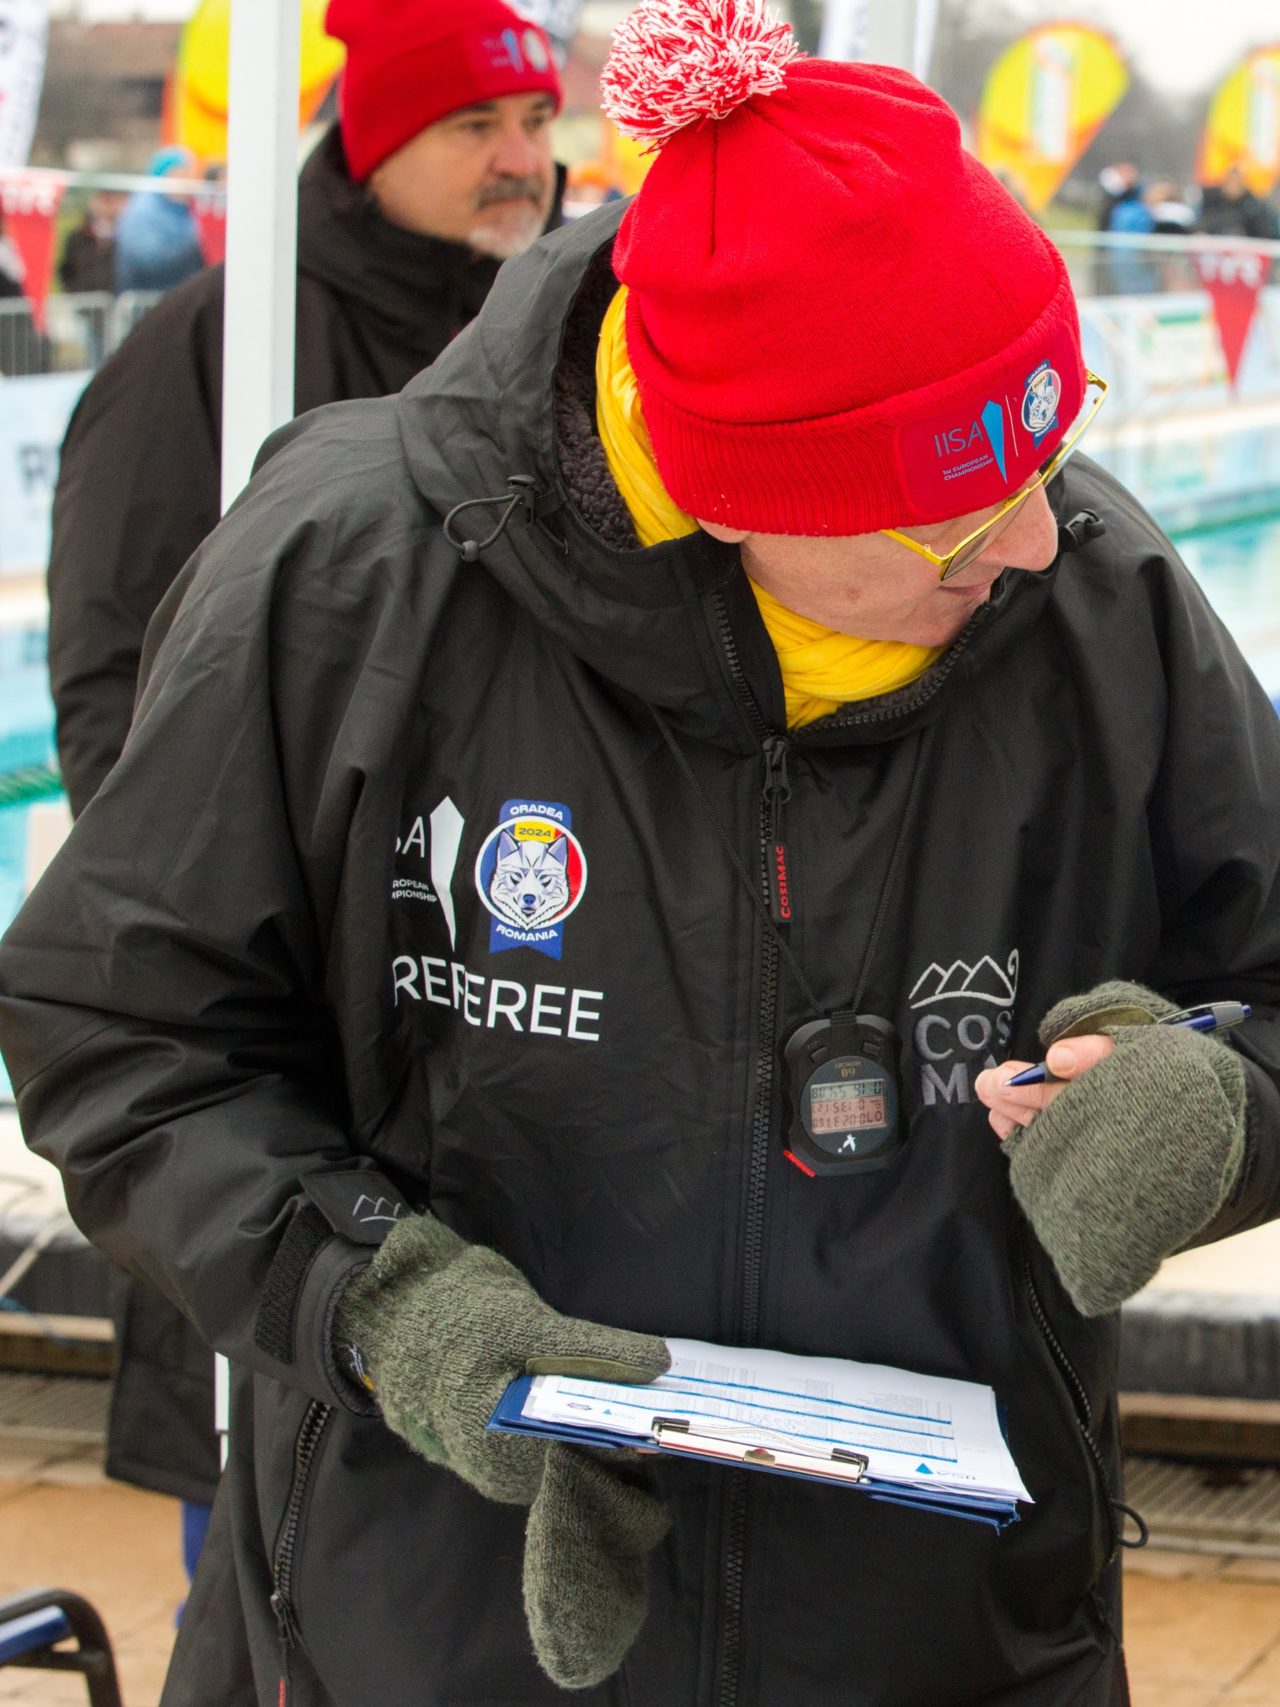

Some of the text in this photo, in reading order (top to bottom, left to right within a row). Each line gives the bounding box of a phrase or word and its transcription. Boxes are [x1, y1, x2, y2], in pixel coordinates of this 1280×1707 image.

[1199, 250, 1261, 288] TYR
[934, 421, 983, 457] IISA
[509, 804, 563, 822] ORADEA
[518, 827, 552, 838] 2024
[495, 924, 558, 942] ROMANIA
[391, 954, 604, 1042] REFEREE
